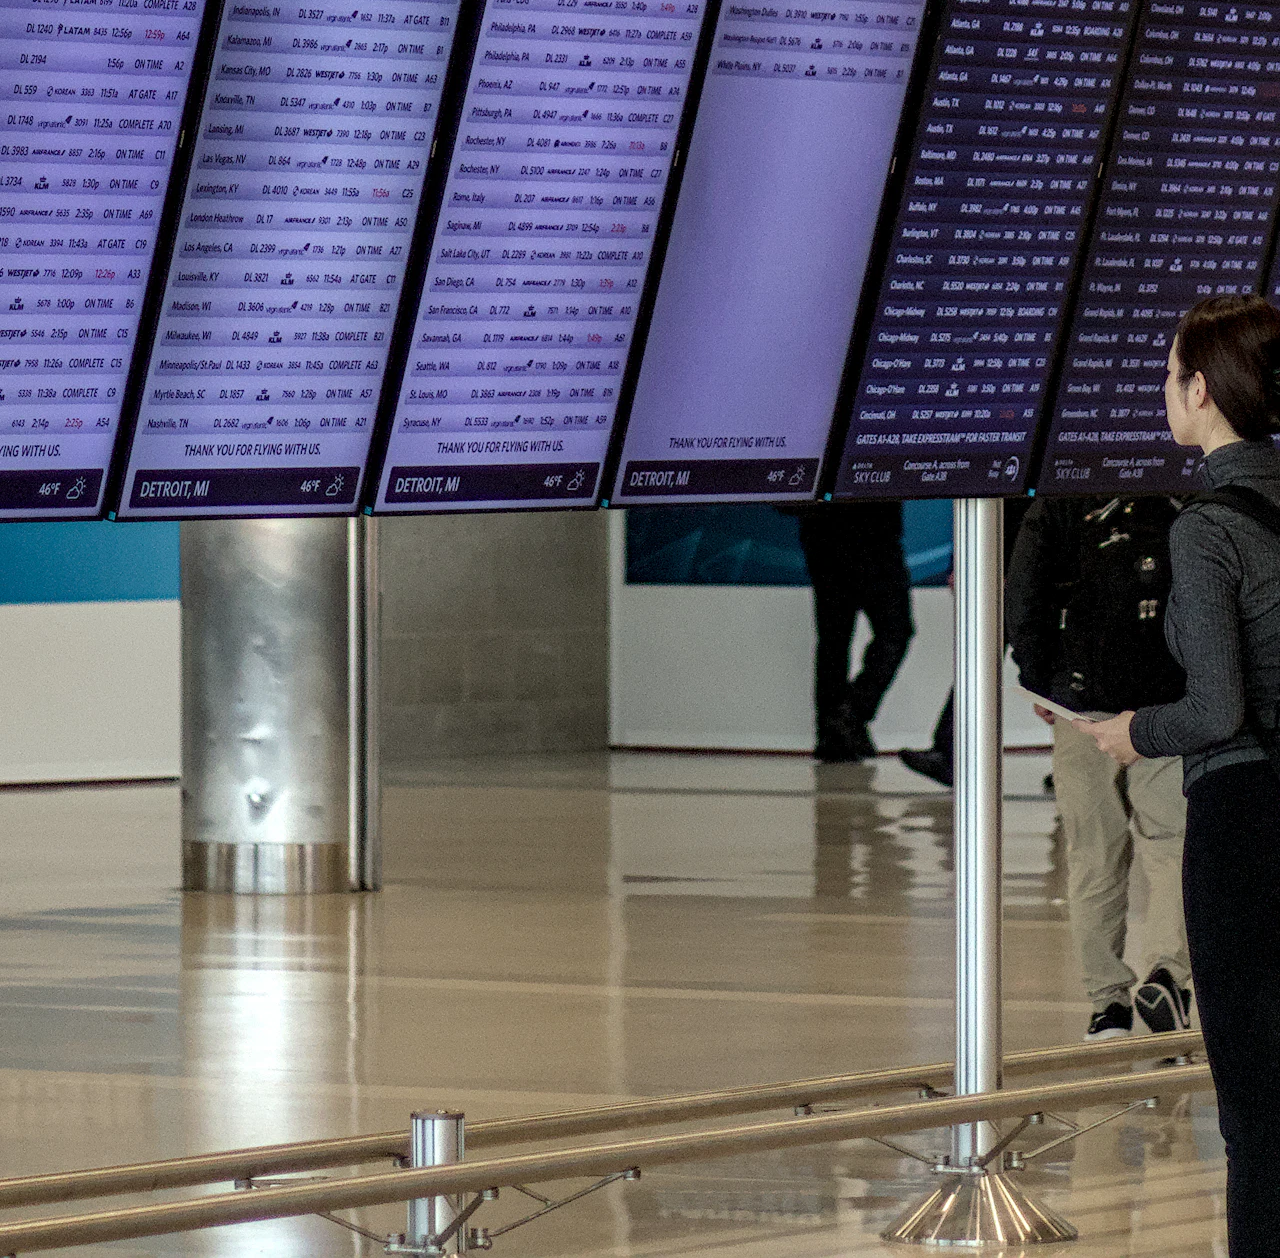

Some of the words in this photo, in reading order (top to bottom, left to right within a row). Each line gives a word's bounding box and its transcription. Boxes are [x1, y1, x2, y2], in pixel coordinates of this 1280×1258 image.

[144, 0, 179, 10] COMPLETE
[183, 1, 197, 11] A28
[670, 437, 693, 448] THANK
[697, 437, 712, 448] YOU
[714, 437, 728, 448] FOR
[729, 437, 753, 448] FLYING
[755, 437, 774, 447] WITH
[776, 436, 786, 447] US.
[857, 434, 877, 444] GATES
[22, 445, 46, 456] WITH
[48, 444, 60, 457] US.
[185, 444, 214, 456] THANK
[217, 444, 235, 456] YOU
[236, 444, 252, 456] FOR
[254, 443, 282, 455] FLYING
[285, 443, 307, 455] WITH
[309, 443, 320, 455] US.
[438, 442, 465, 453] THANK
[468, 442, 484, 453] YOU
[485, 441, 501, 453] FOR
[503, 441, 528, 452] FLYING
[530, 440, 551, 451] WITH
[553, 440, 563, 452] US.
[395, 477, 443, 494] DETROIT,
[445, 477, 460, 491] MI
[630, 471, 674, 488] DETROIT,
[676, 471, 690, 485] MI
[140, 481, 191, 499] DETROIT,
[194, 481, 210, 496] MI
